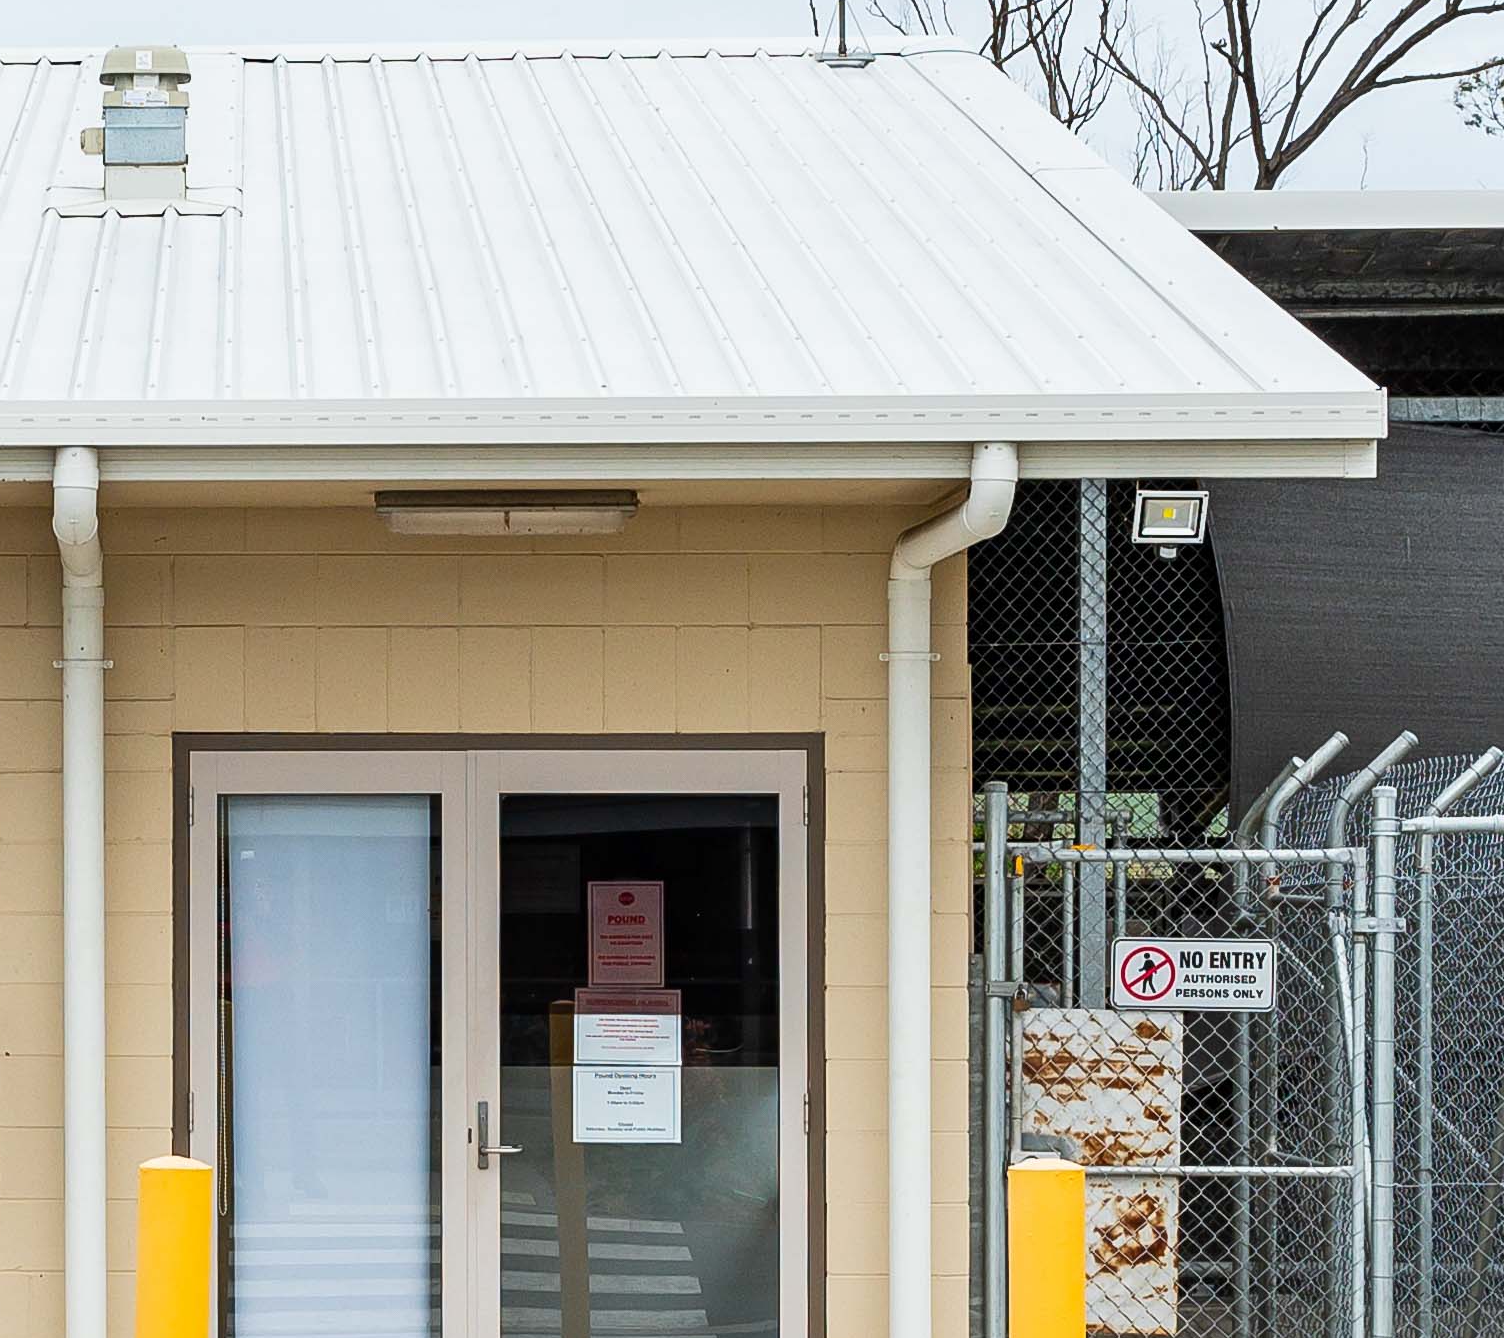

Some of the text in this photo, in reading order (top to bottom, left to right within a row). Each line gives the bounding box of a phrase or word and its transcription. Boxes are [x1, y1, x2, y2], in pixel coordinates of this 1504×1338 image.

[607, 915, 646, 925] POUND
[1179, 951, 1267, 970] NO ENTRY
[1183, 974, 1257, 985] AUTHORISED
[1175, 988, 1264, 999] PERSONS ONLY
